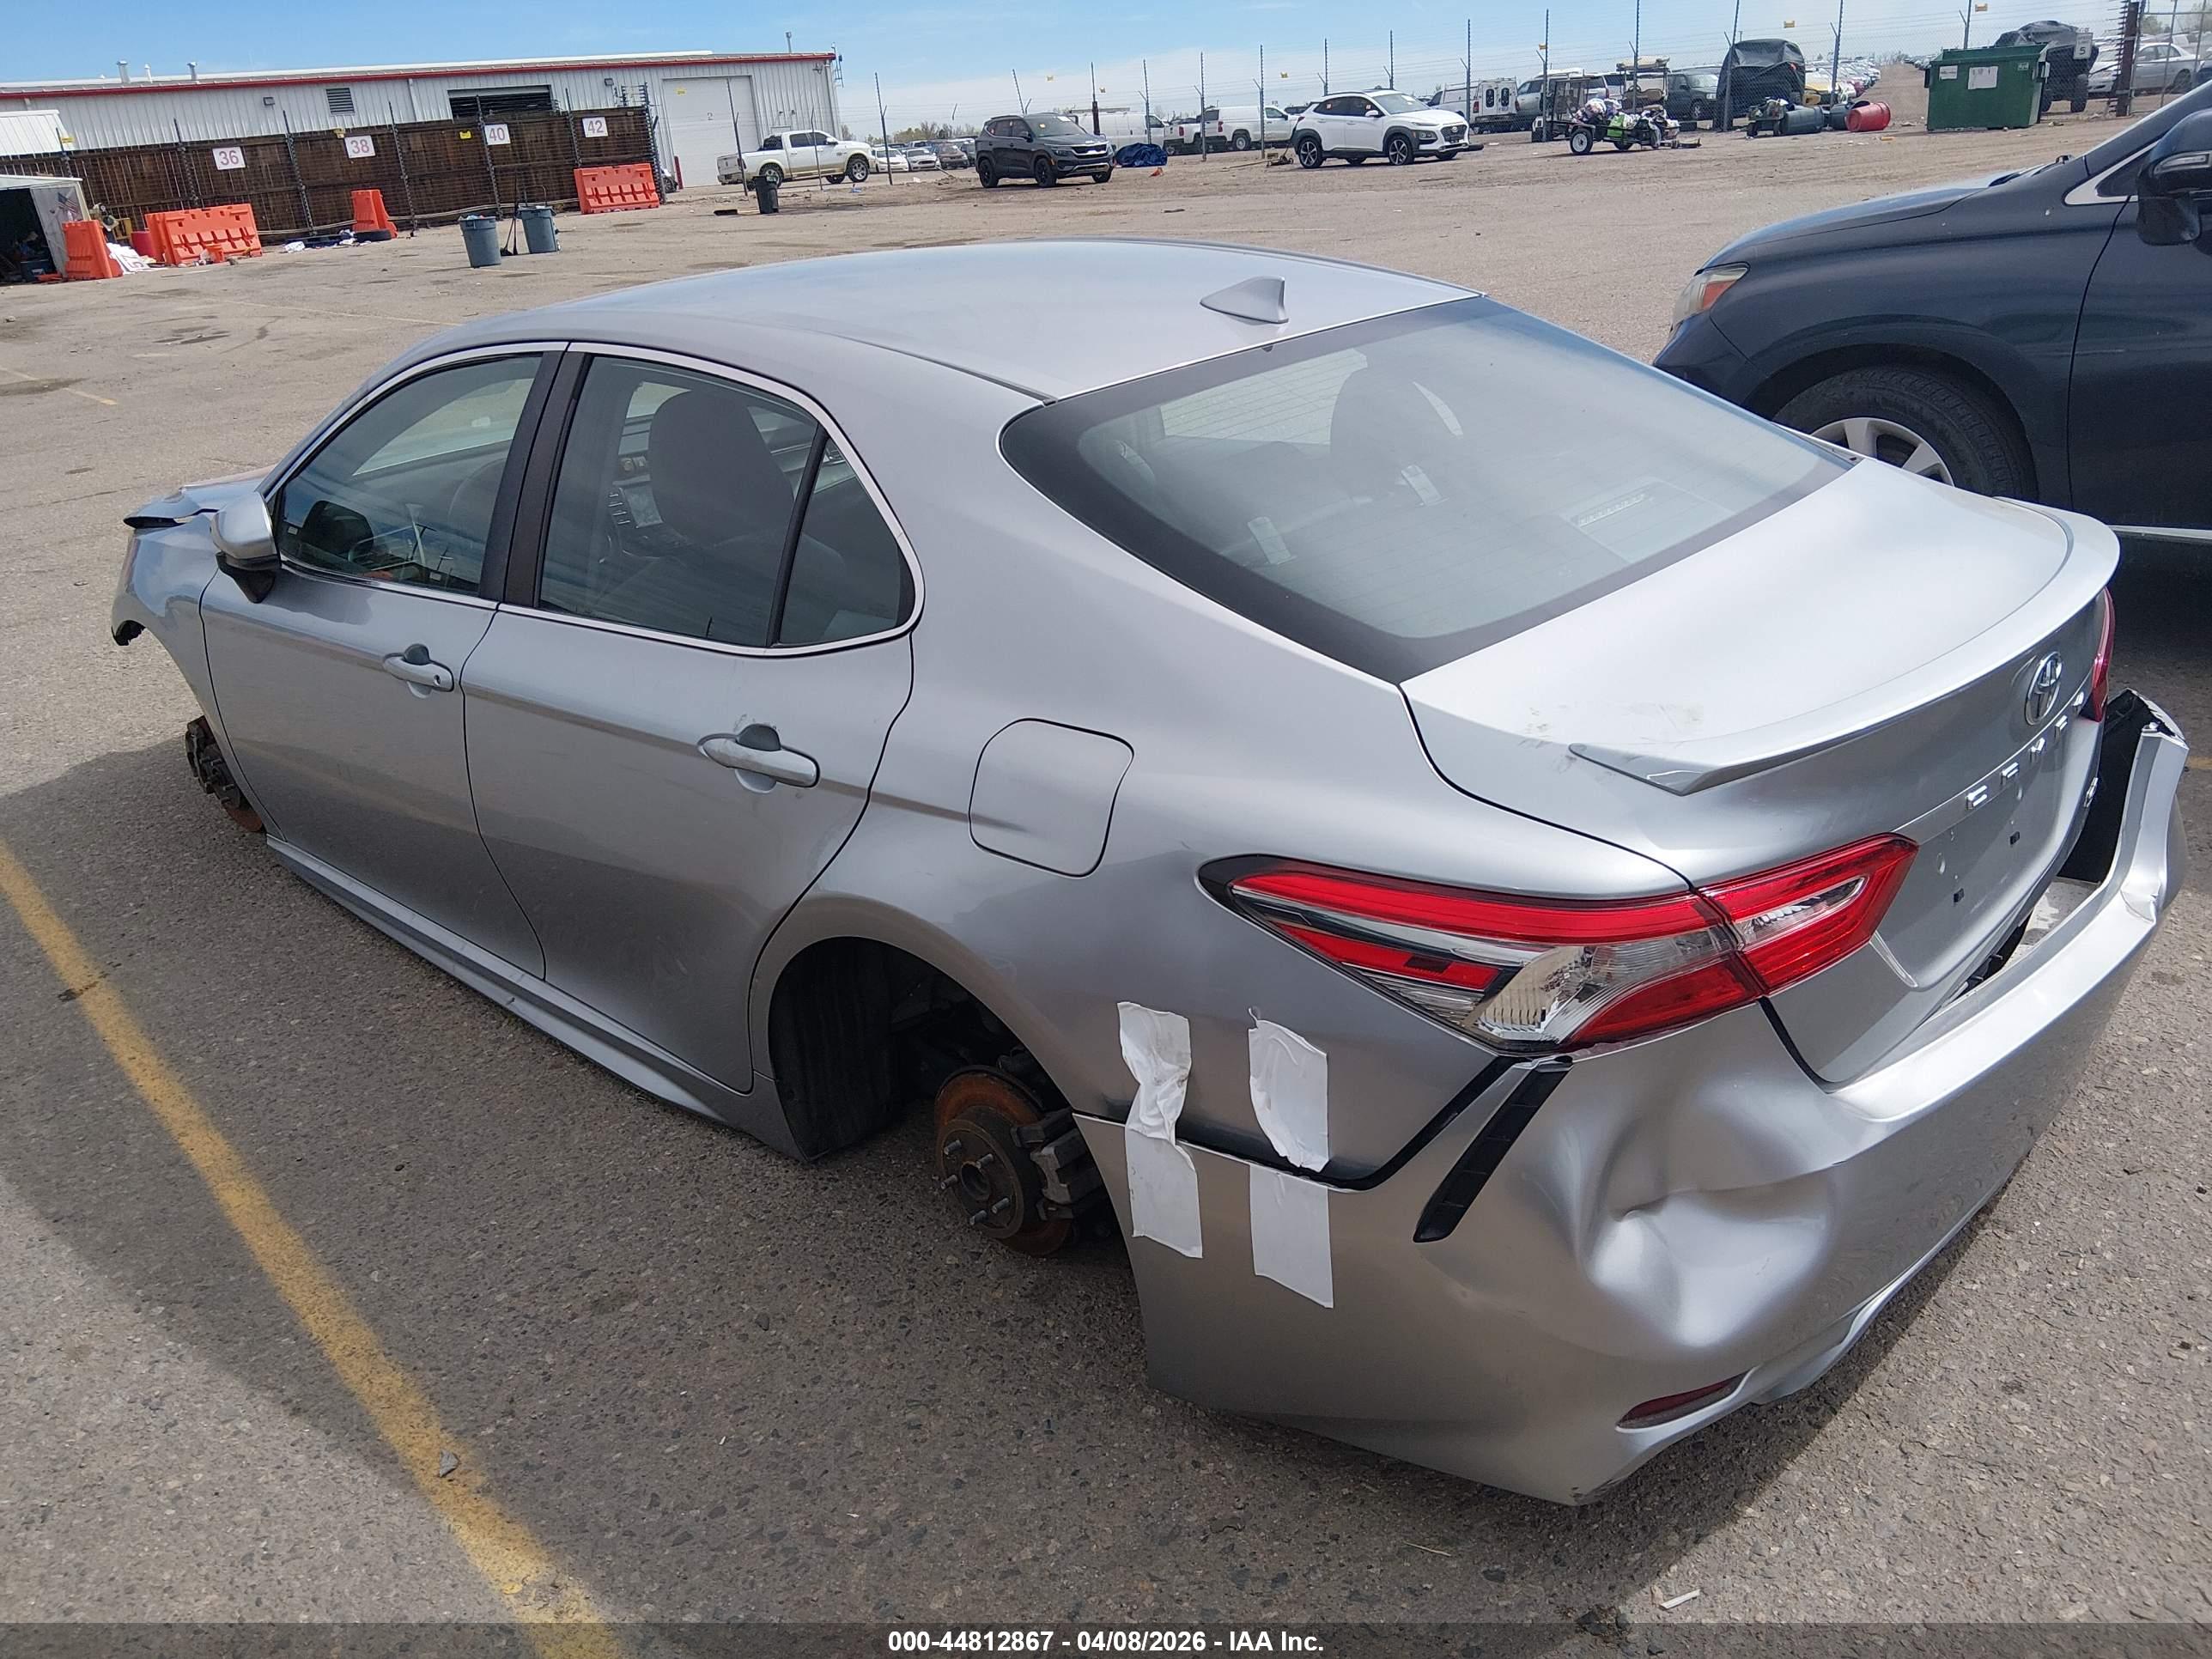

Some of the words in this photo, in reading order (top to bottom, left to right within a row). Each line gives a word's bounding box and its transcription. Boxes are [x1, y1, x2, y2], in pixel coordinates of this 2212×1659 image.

[2079, 46, 2086, 55] 5
[707, 112, 714, 121] 2
[587, 119, 605, 134] 42
[489, 127, 505, 142] 40
[350, 138, 370, 155] 38
[219, 149, 239, 166] 36
